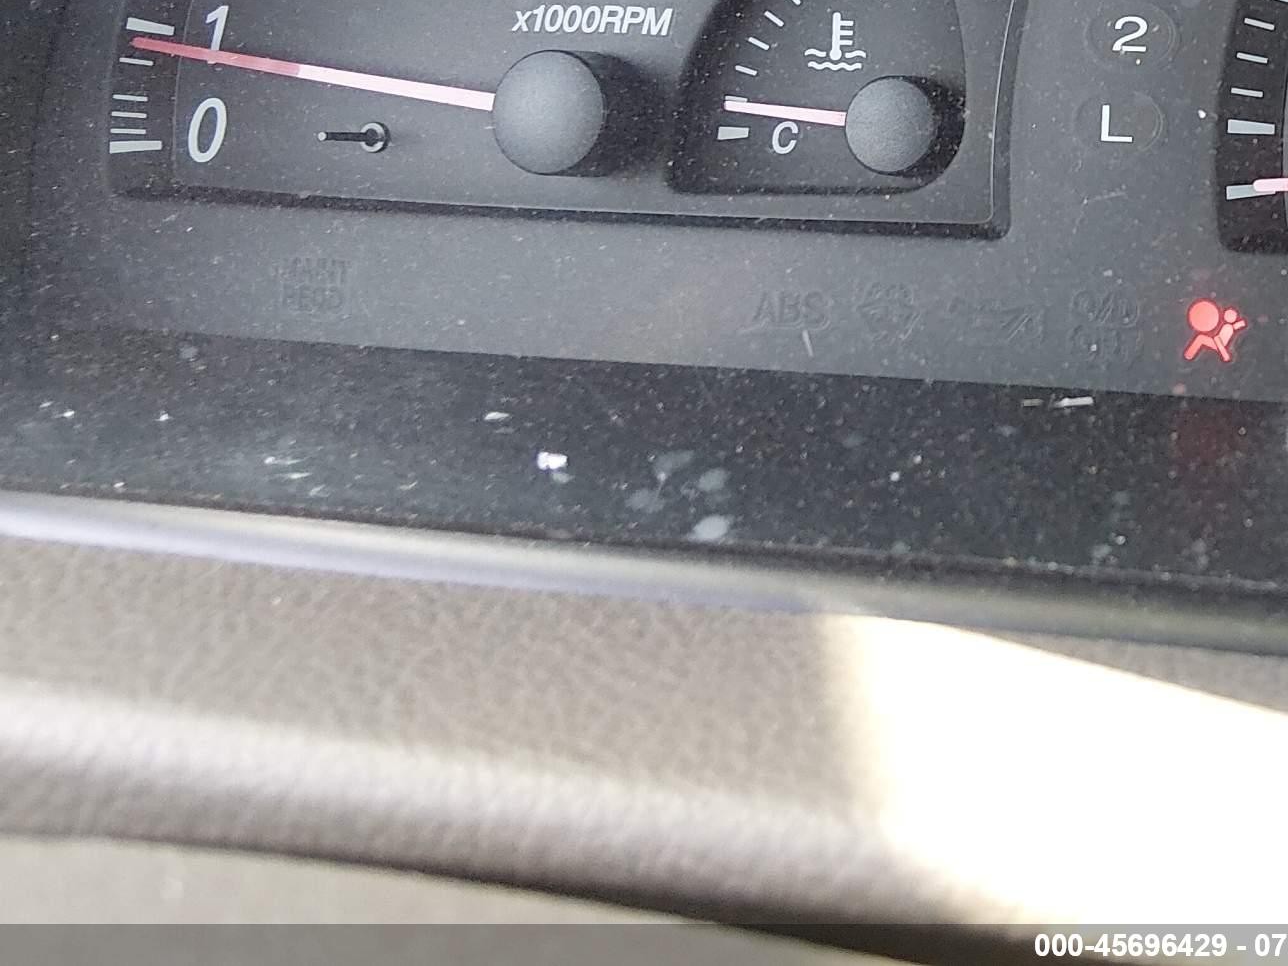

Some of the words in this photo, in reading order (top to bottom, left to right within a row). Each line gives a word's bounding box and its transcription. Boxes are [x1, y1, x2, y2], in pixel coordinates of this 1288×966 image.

[205, 4, 229, 65] 1
[511, 3, 674, 37] x1000RPM
[1111, 15, 1149, 54] 2
[187, 97, 228, 164] 0
[771, 121, 799, 155] C
[1099, 103, 1134, 144] L
